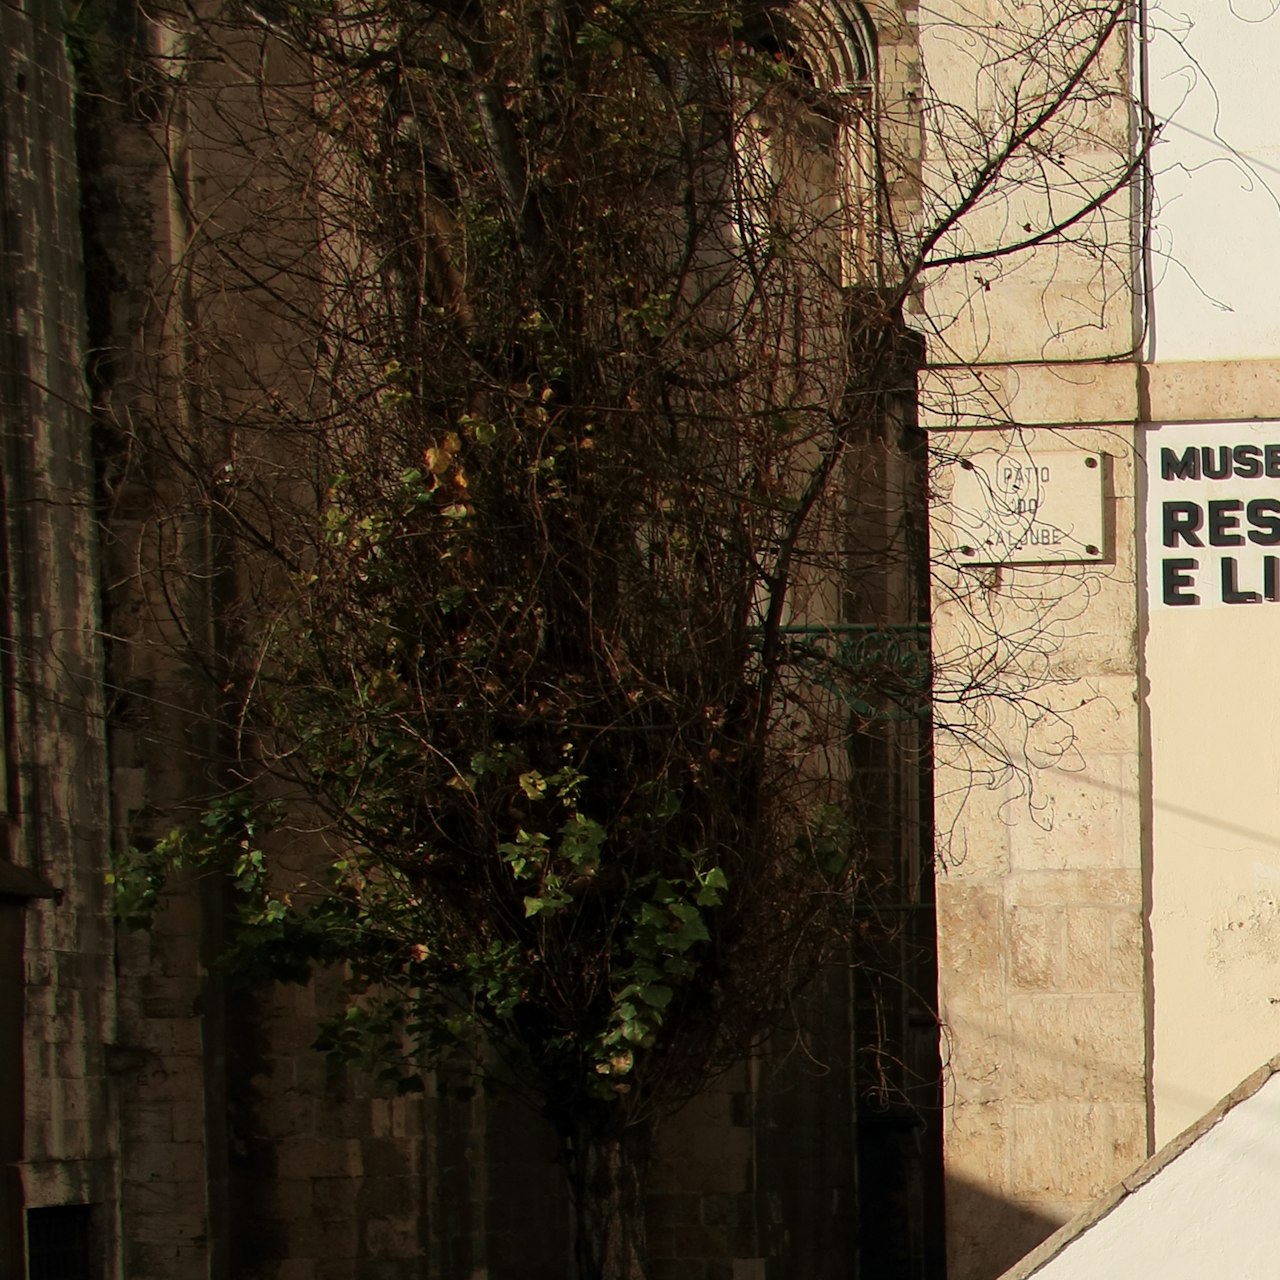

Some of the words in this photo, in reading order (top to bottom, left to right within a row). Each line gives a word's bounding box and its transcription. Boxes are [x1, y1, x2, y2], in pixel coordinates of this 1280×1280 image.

[1017, 498, 1038, 513] DO
[996, 529, 1062, 546] ALJUBE
[1162, 557, 1200, 605] E
